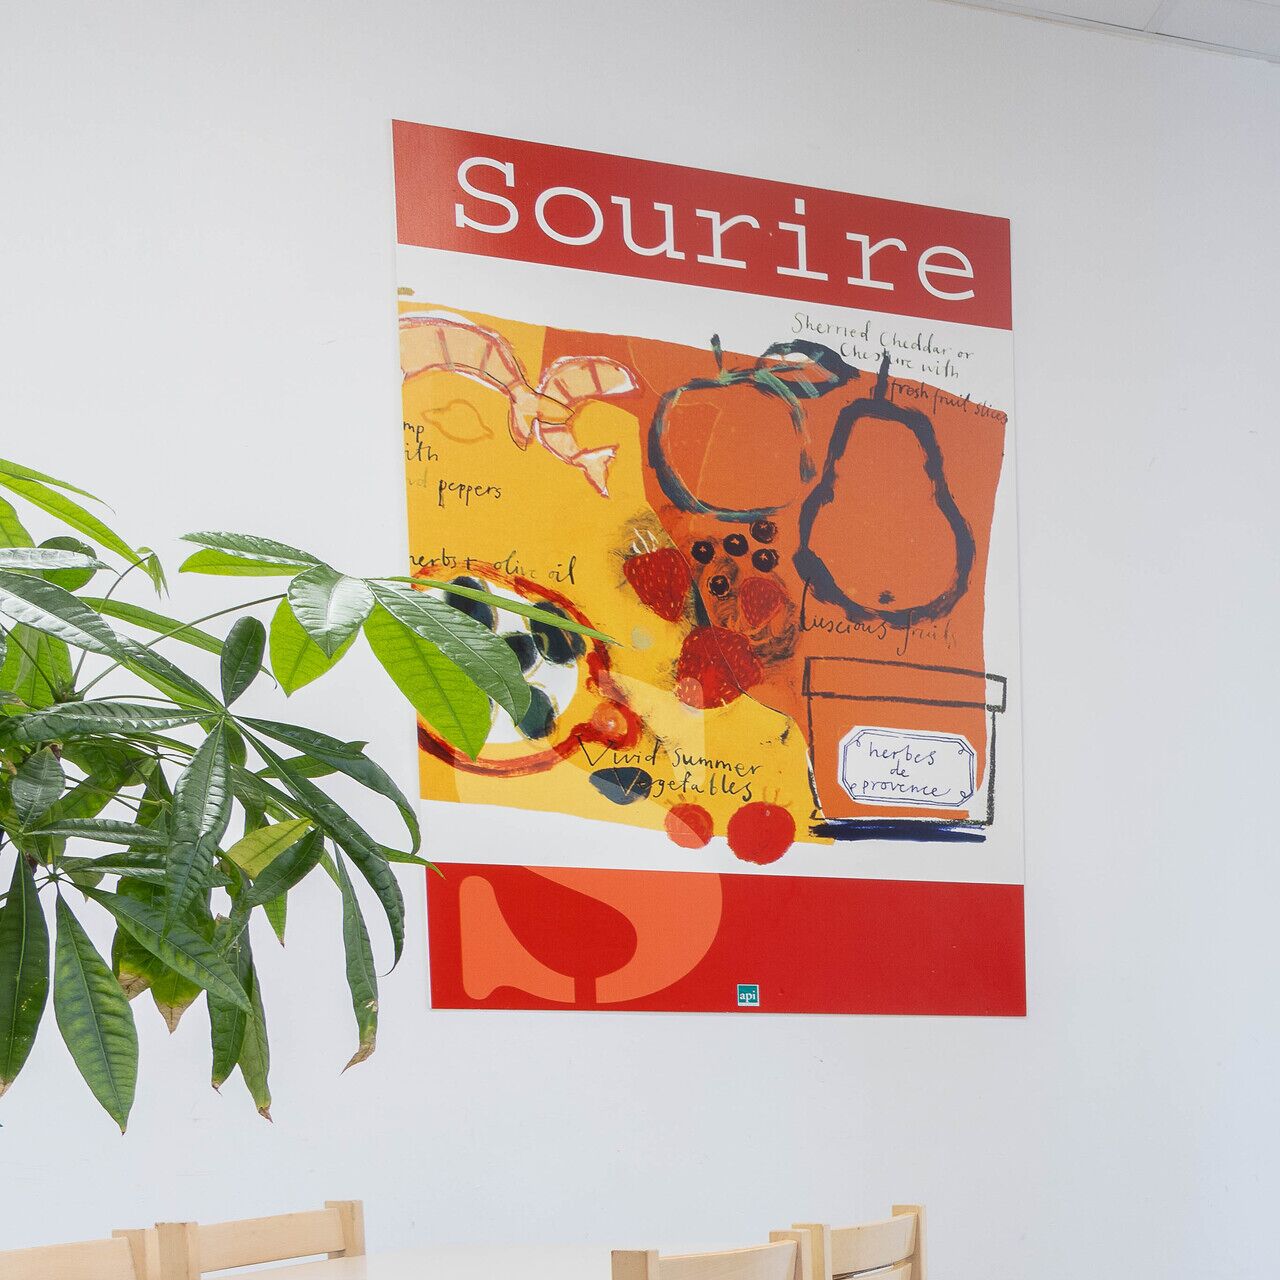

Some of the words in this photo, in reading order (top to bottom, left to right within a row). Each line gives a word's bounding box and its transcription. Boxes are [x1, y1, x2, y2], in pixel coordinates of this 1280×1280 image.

[455, 156, 975, 301] Sourire
[791, 312, 871, 341] Sherried
[879, 331, 948, 355] Cheddar
[957, 350, 974, 361] or
[921, 360, 960, 379] with
[932, 389, 971, 415] fruit
[438, 479, 502, 508] peppers
[493, 550, 536, 579] olive
[549, 556, 577, 585] oil
[868, 741, 937, 766] herbes
[889, 758, 910, 778] de
[613, 767, 753, 802] Vegetables
[862, 780, 951, 797] provence
[739, 990, 756, 1003] api
